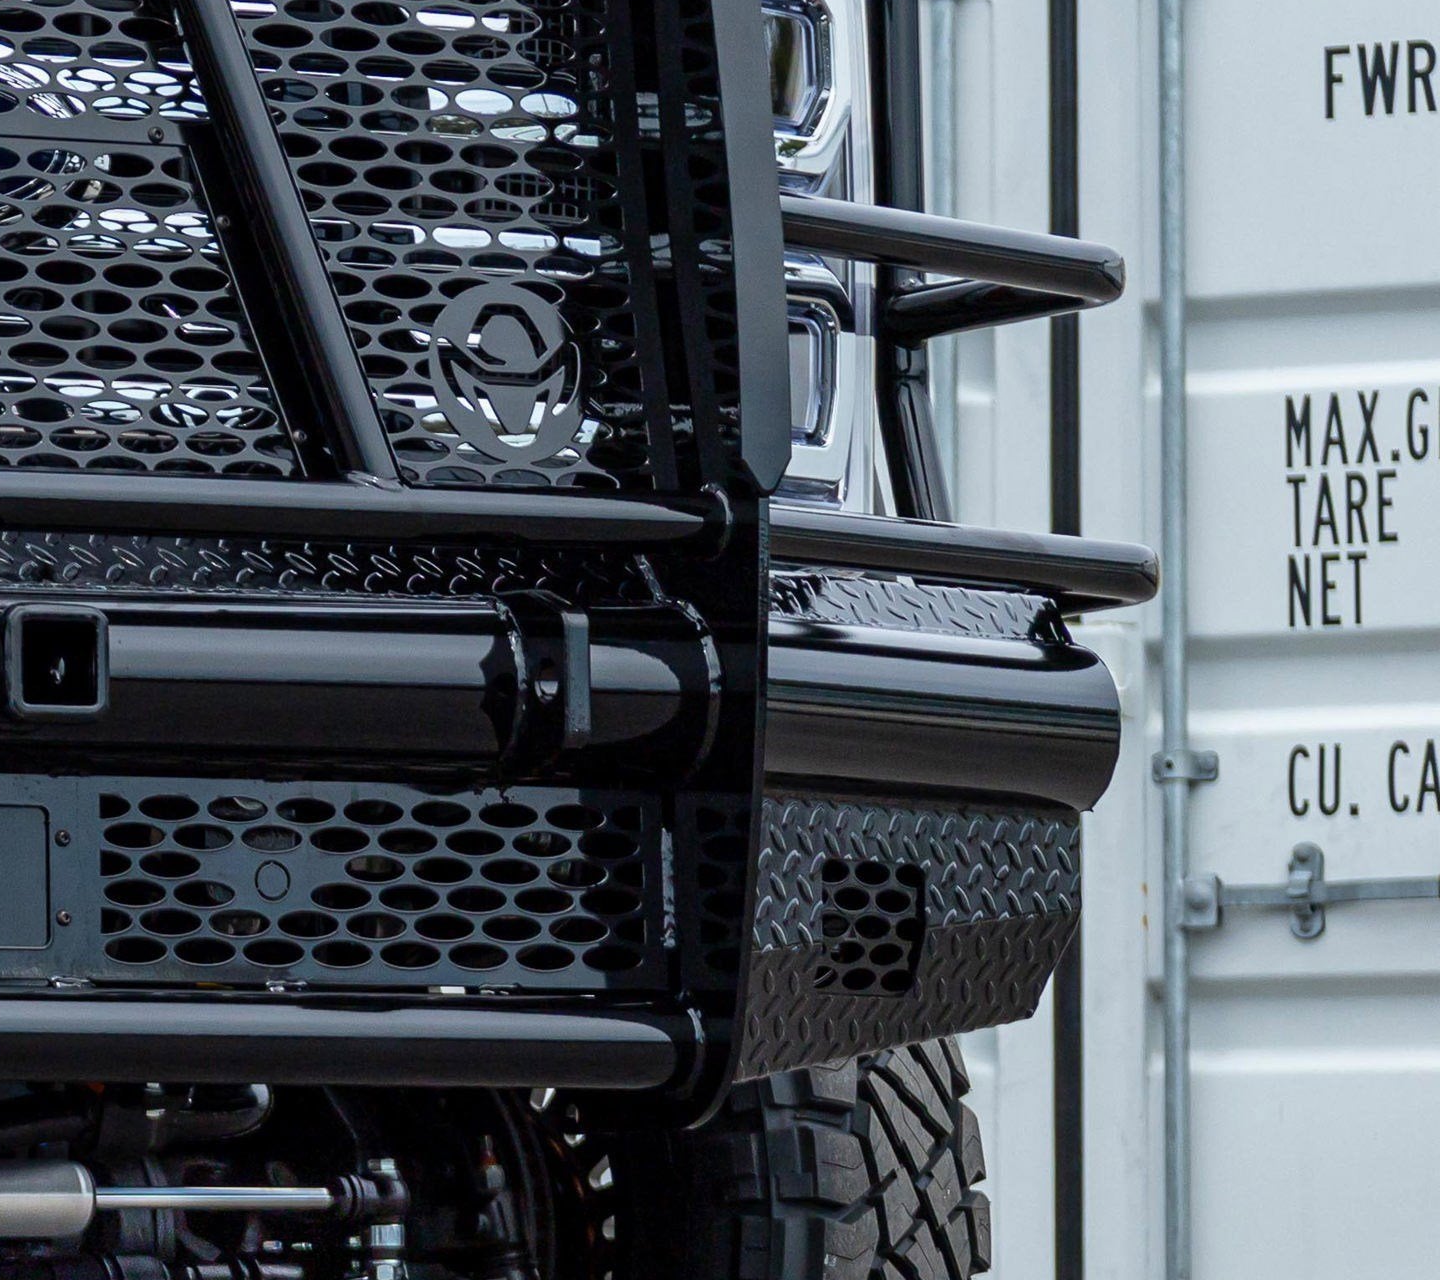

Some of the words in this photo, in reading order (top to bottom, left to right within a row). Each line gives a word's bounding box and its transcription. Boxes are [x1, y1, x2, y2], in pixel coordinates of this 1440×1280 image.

[1324, 39, 1437, 120] FWR
[1286, 387, 1440, 468] MAX.G
[1287, 469, 1399, 547] TARE
[1288, 550, 1368, 628] NET
[1288, 742, 1360, 817] CU.
